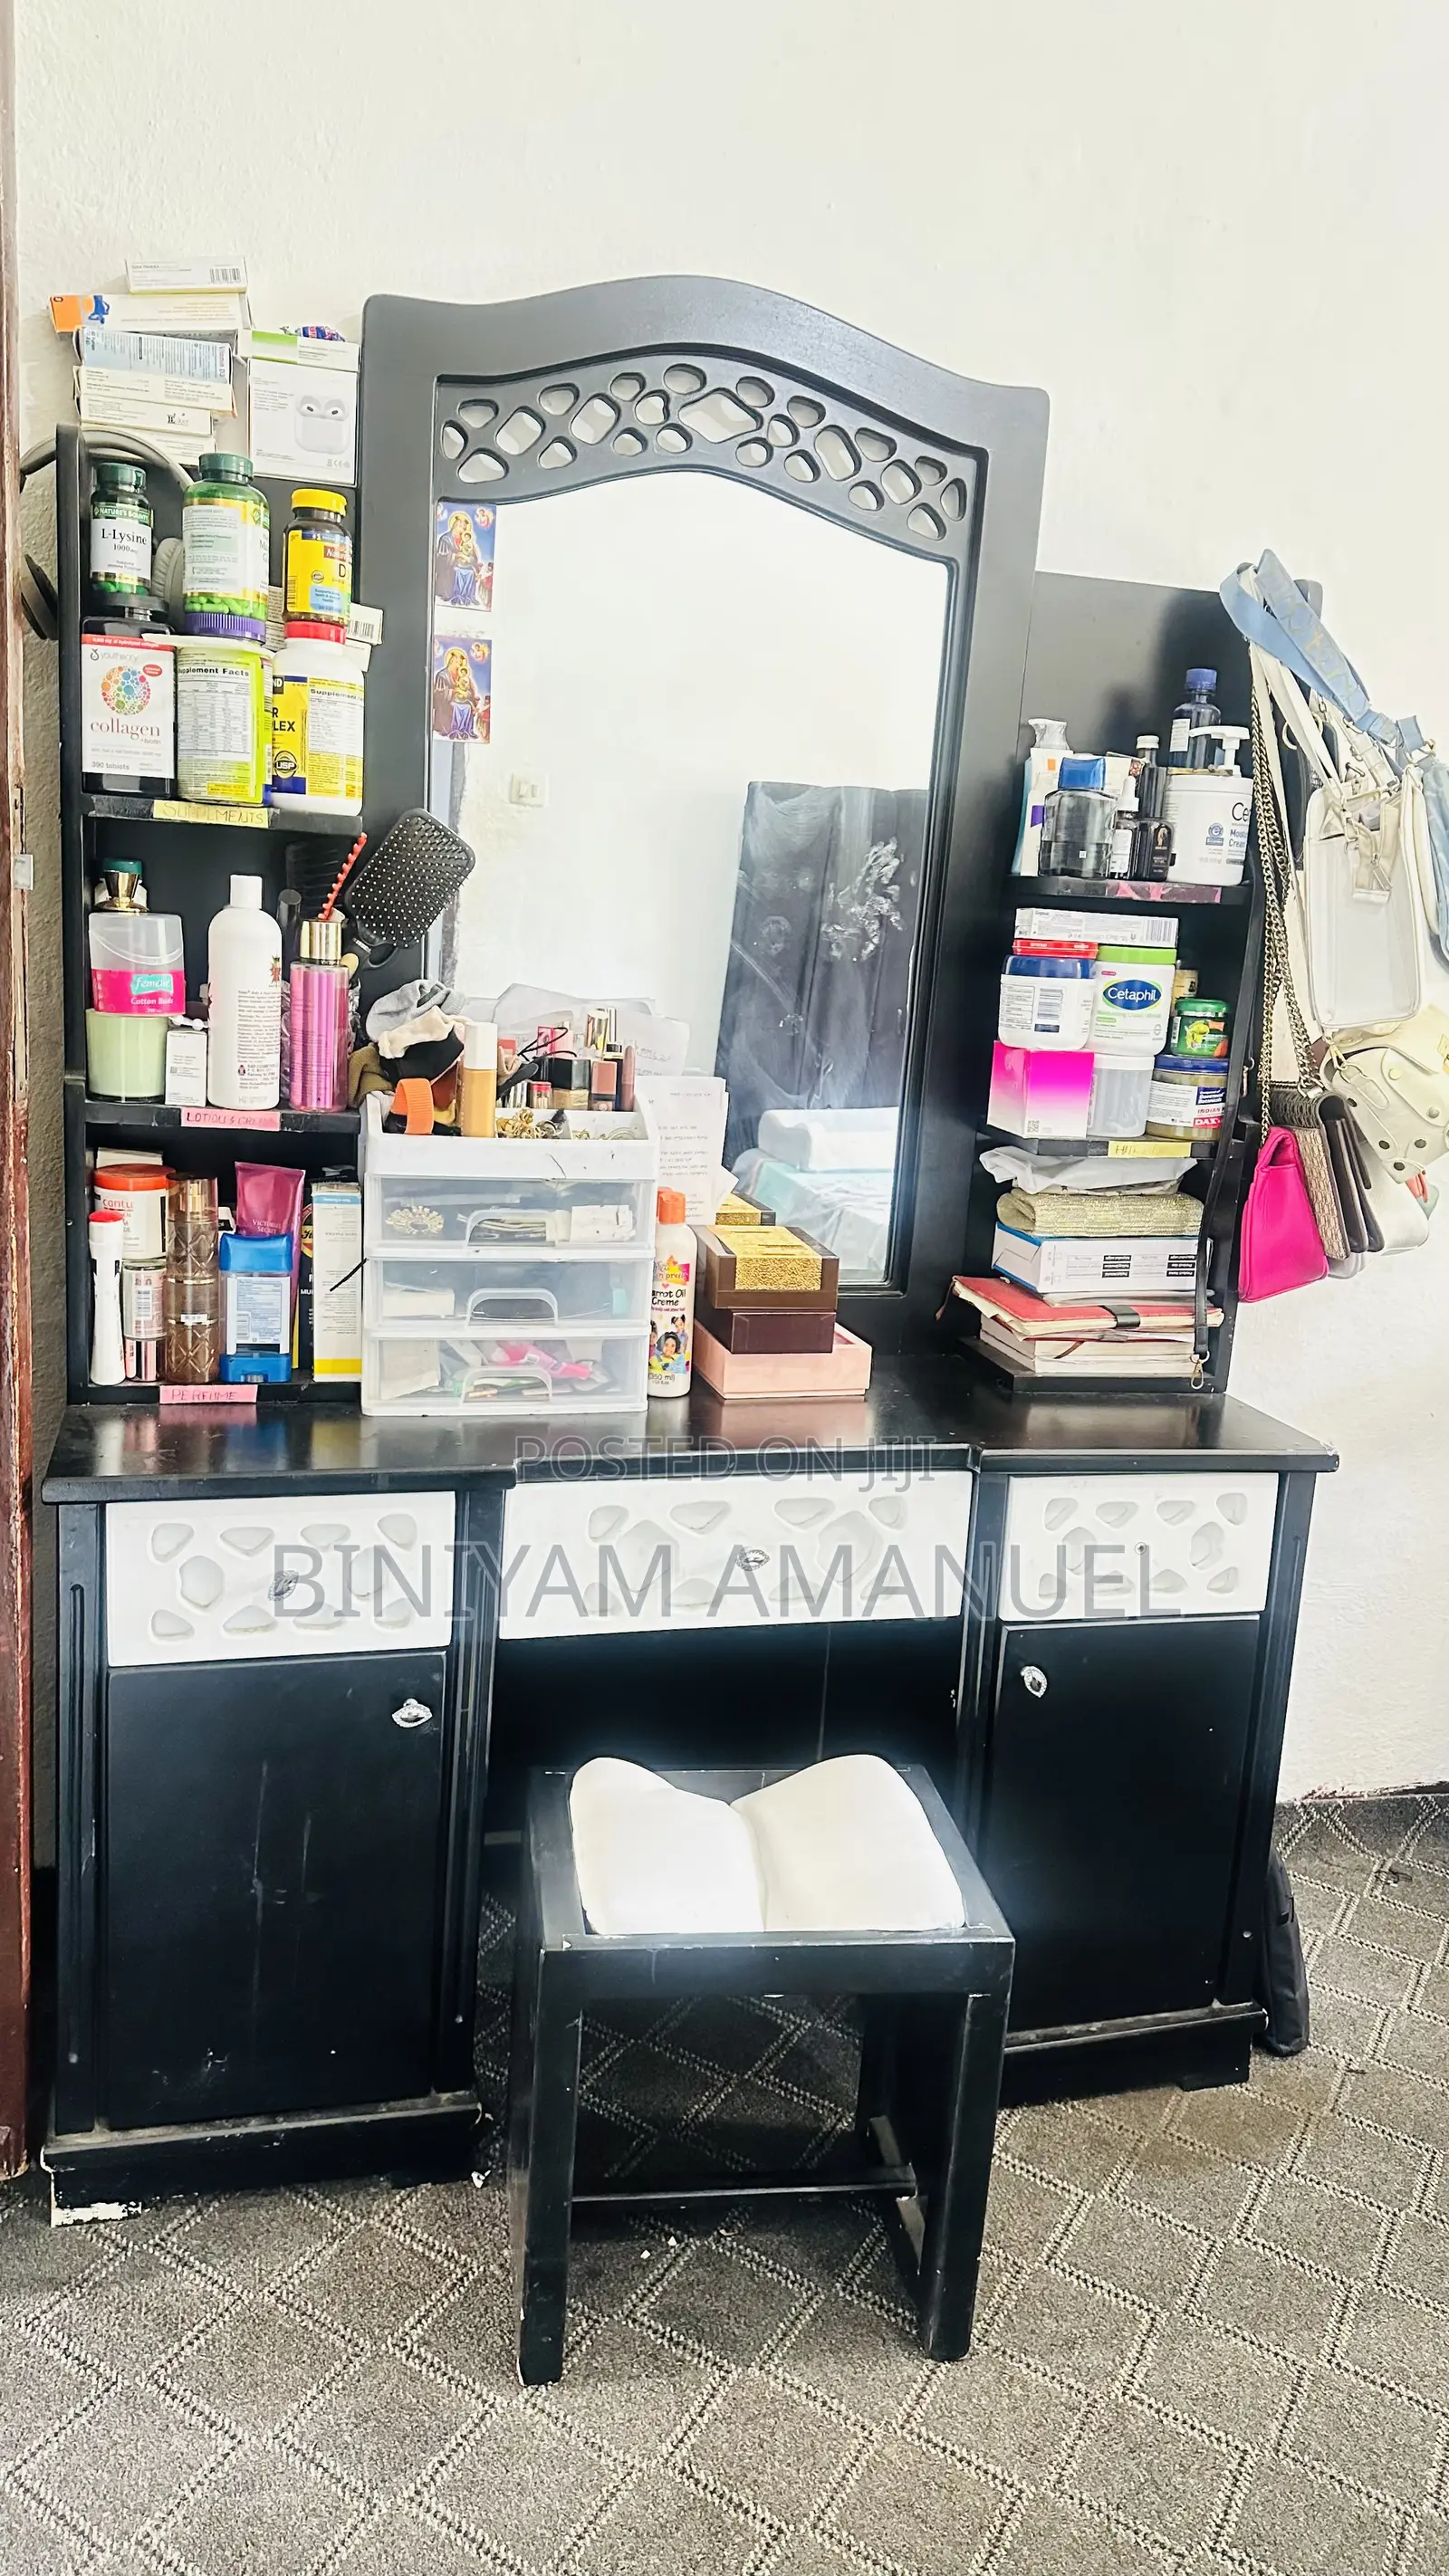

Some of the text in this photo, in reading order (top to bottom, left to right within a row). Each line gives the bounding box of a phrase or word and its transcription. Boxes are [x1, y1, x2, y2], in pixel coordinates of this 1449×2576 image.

[101, 528, 147, 545] L-Lysine
[113, 543, 130, 552] 1000
[178, 666, 250, 677] upplement Facts
[91, 716, 160, 741] collagen
[91, 761, 130, 771] 390 tablets
[276, 761, 295, 770] USP
[1108, 987, 1156, 1003] Cetaphil
[130, 997, 157, 1006] Cotton
[1195, 1117, 1217, 1126] DAX
[102, 1198, 135, 1209] cantu
[256, 1225, 277, 1234] SECRET
[651, 1288, 686, 1298] arrot Oil
[651, 1296, 679, 1306] Creme
[171, 1388, 237, 1402] PERFUME
